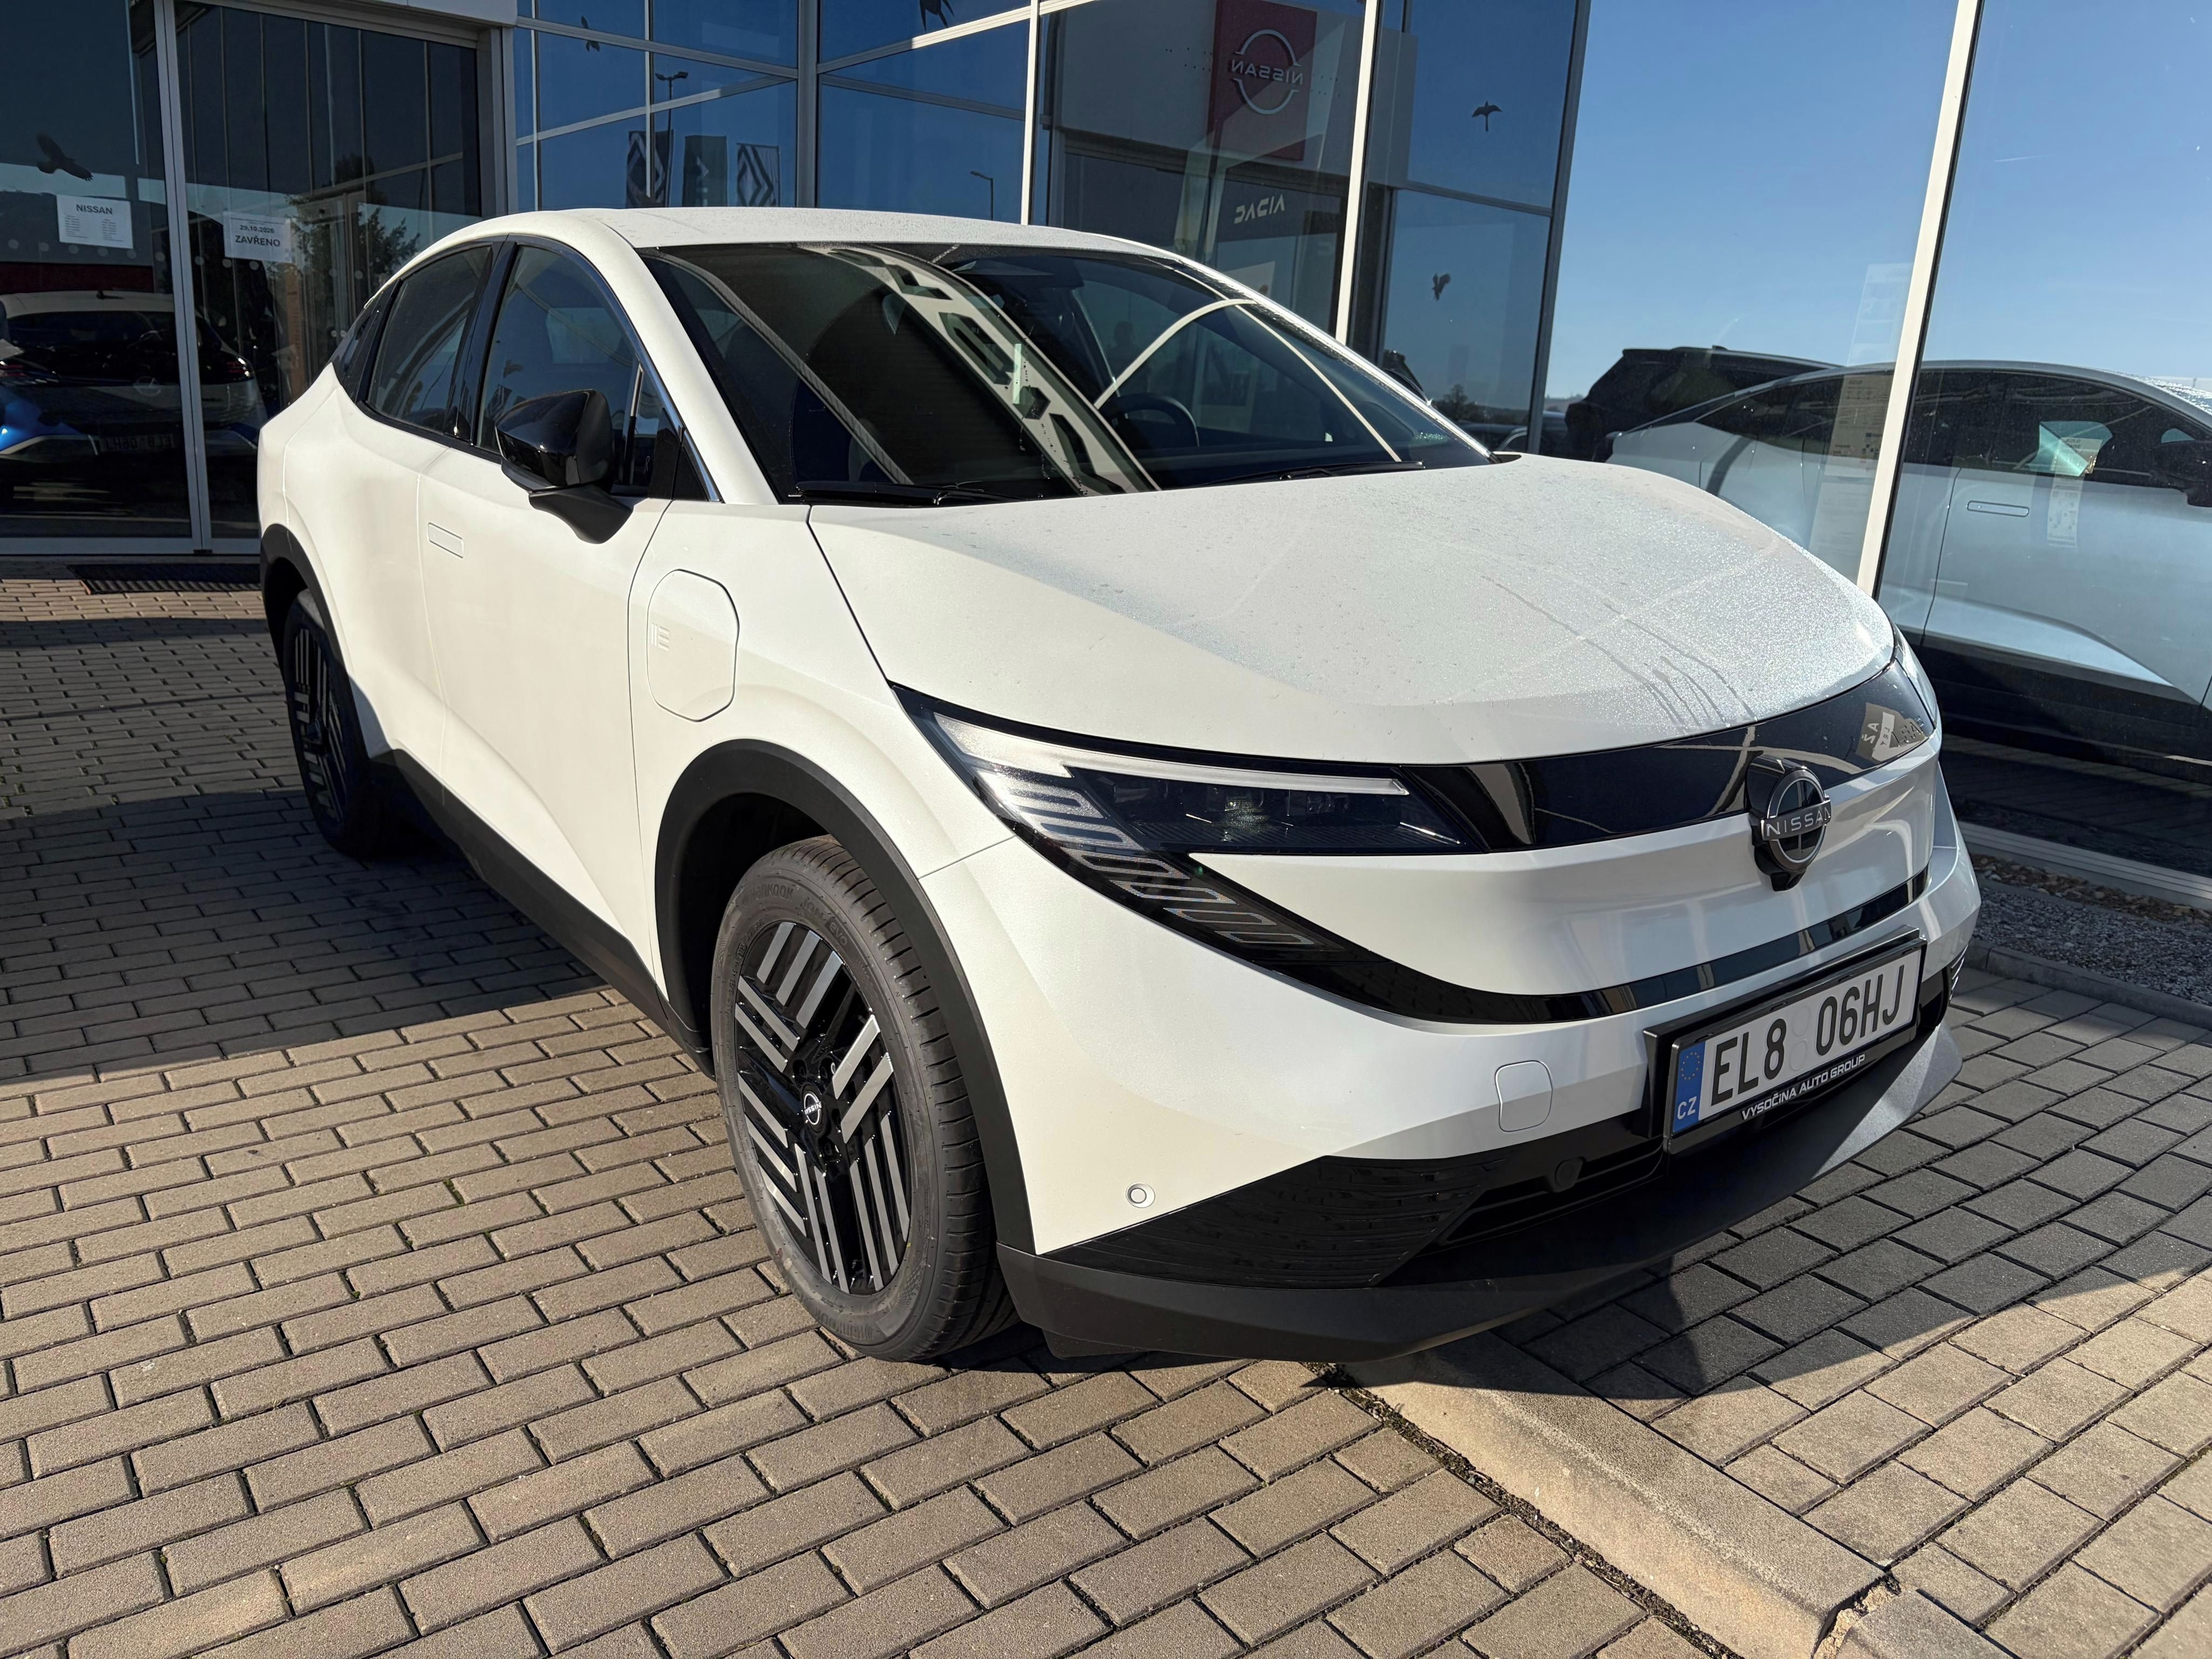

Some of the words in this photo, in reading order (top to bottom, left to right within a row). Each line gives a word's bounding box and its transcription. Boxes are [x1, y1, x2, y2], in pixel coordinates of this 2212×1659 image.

[76, 204, 113, 215] NISSAN
[1234, 194, 1285, 224] DACIA
[235, 235, 280, 247] ZAVŘENO
[1766, 806, 1831, 837] NISSAN
[830, 922, 848, 946] evo
[1711, 1018, 1787, 1106] EL8
[1816, 965, 1905, 1056] 06HJ
[1742, 1087, 1797, 1121] VYSOČINA
[1799, 1071, 1828, 1095] AUTO
[1830, 1054, 1865, 1080] GROUP
[1677, 1096, 1697, 1120] CZ
